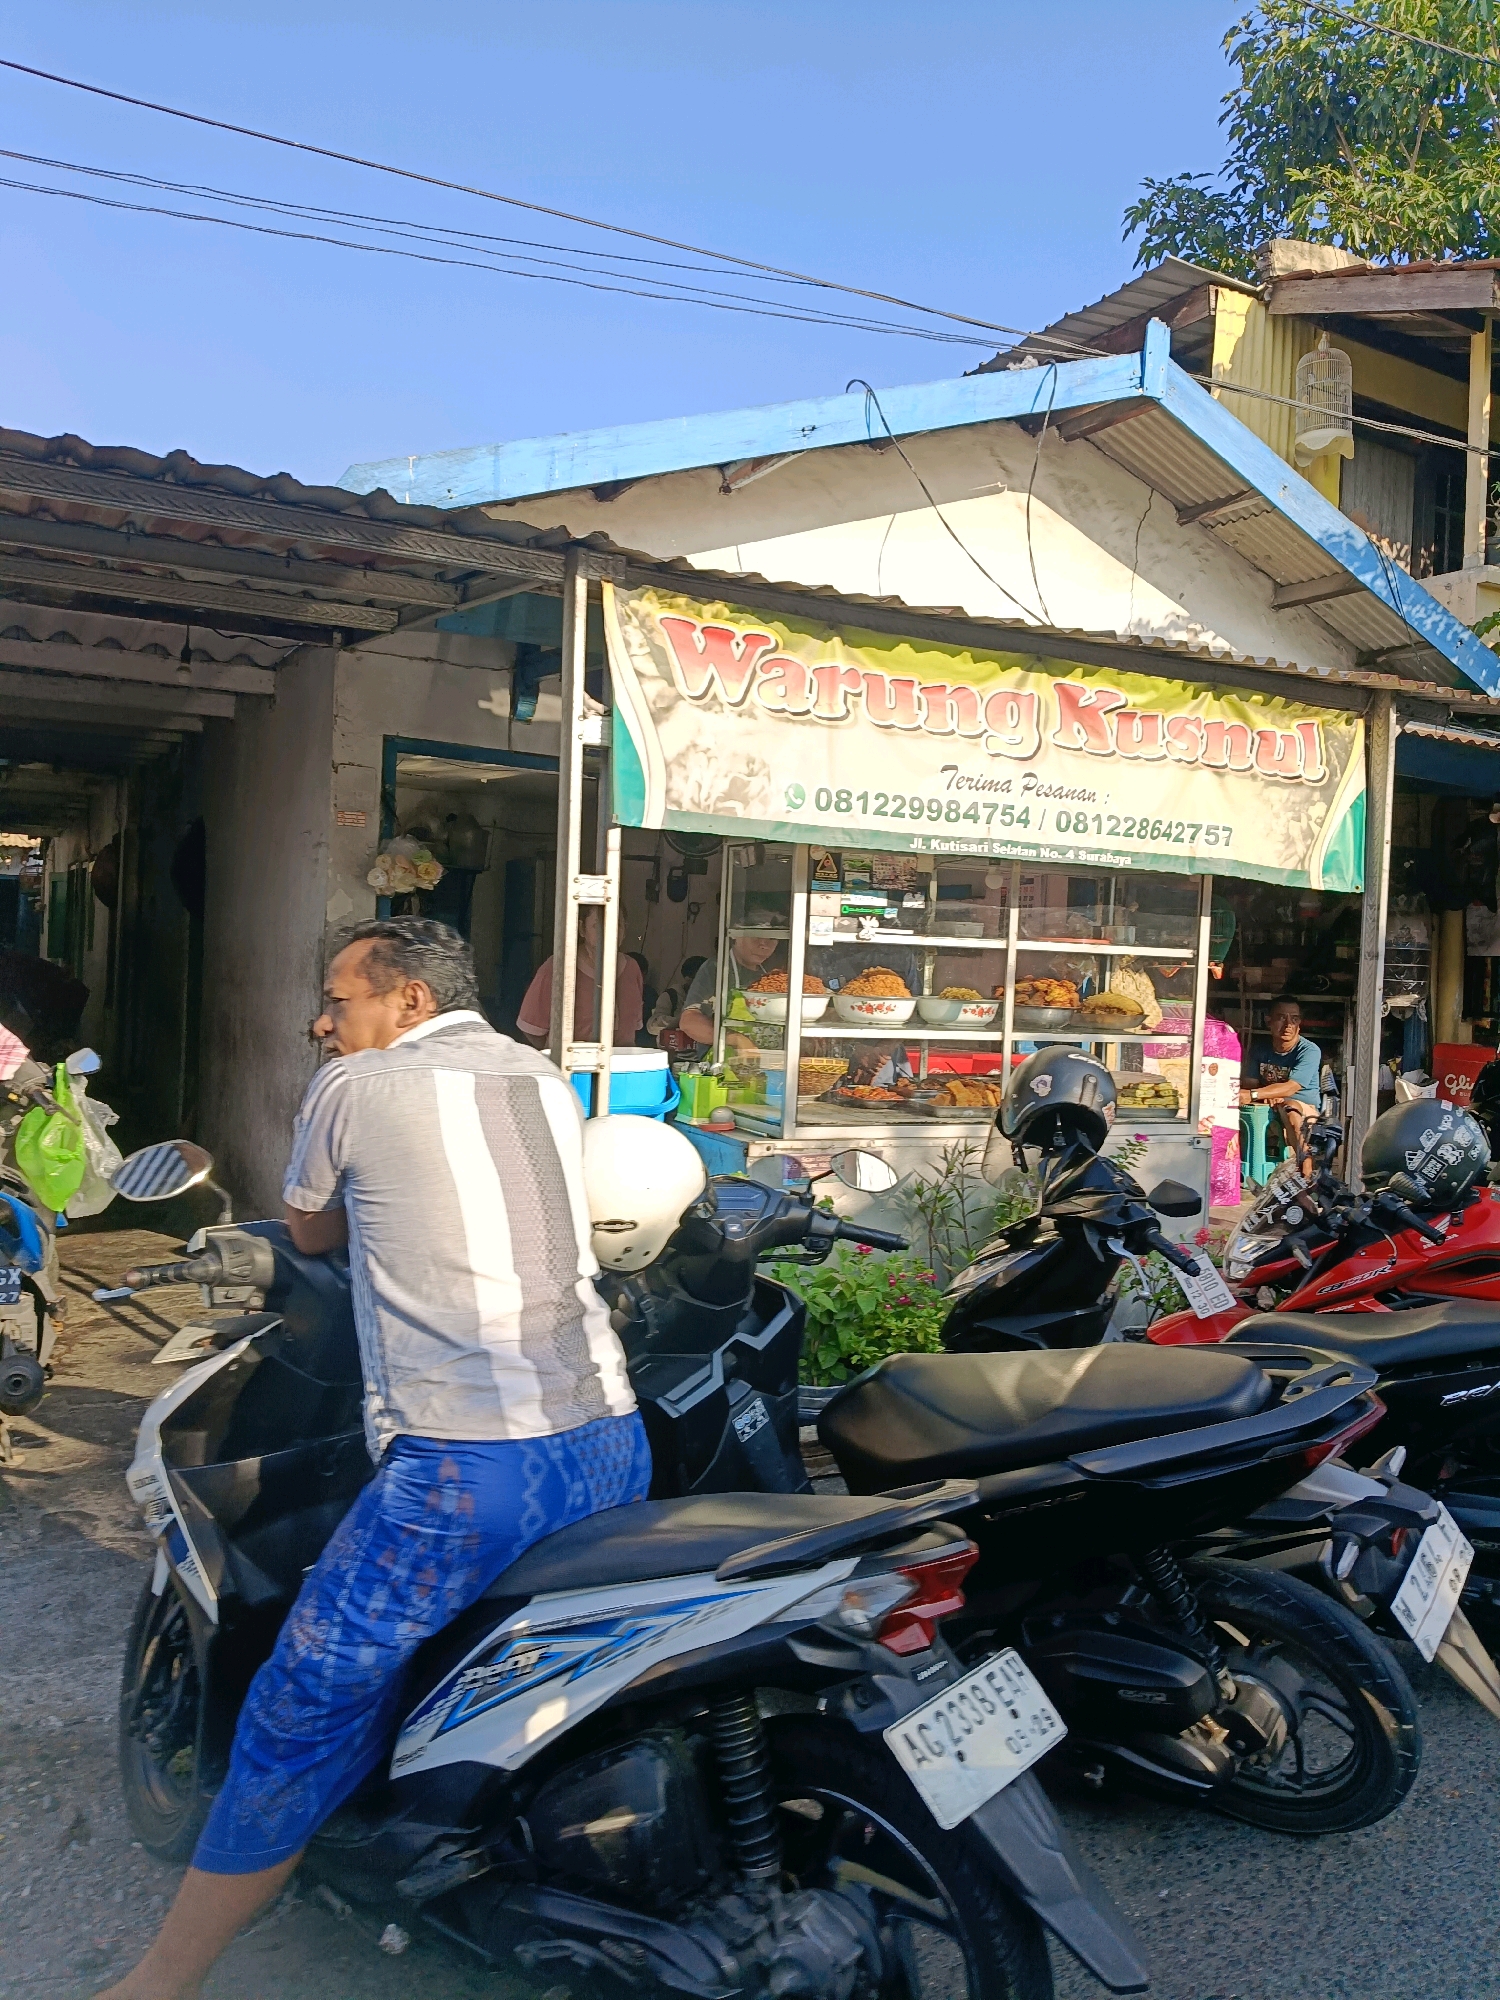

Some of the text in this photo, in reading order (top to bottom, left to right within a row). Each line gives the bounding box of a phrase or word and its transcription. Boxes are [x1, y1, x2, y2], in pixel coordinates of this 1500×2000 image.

[660, 617, 1326, 784] Warung Kusnul
[940, 764, 1013, 793] Terima
[1021, 772, 1097, 803] Pesanan
[815, 787, 1031, 829] 081229984754
[1056, 810, 1233, 847] 081228642757
[909, 837, 1132, 867] Jl. Kutisari Selatan No. 4 Surabaya
[1444, 1073, 1476, 1096] Gli
[901, 1722, 946, 1769] AG
[934, 1684, 997, 1747] 2338
